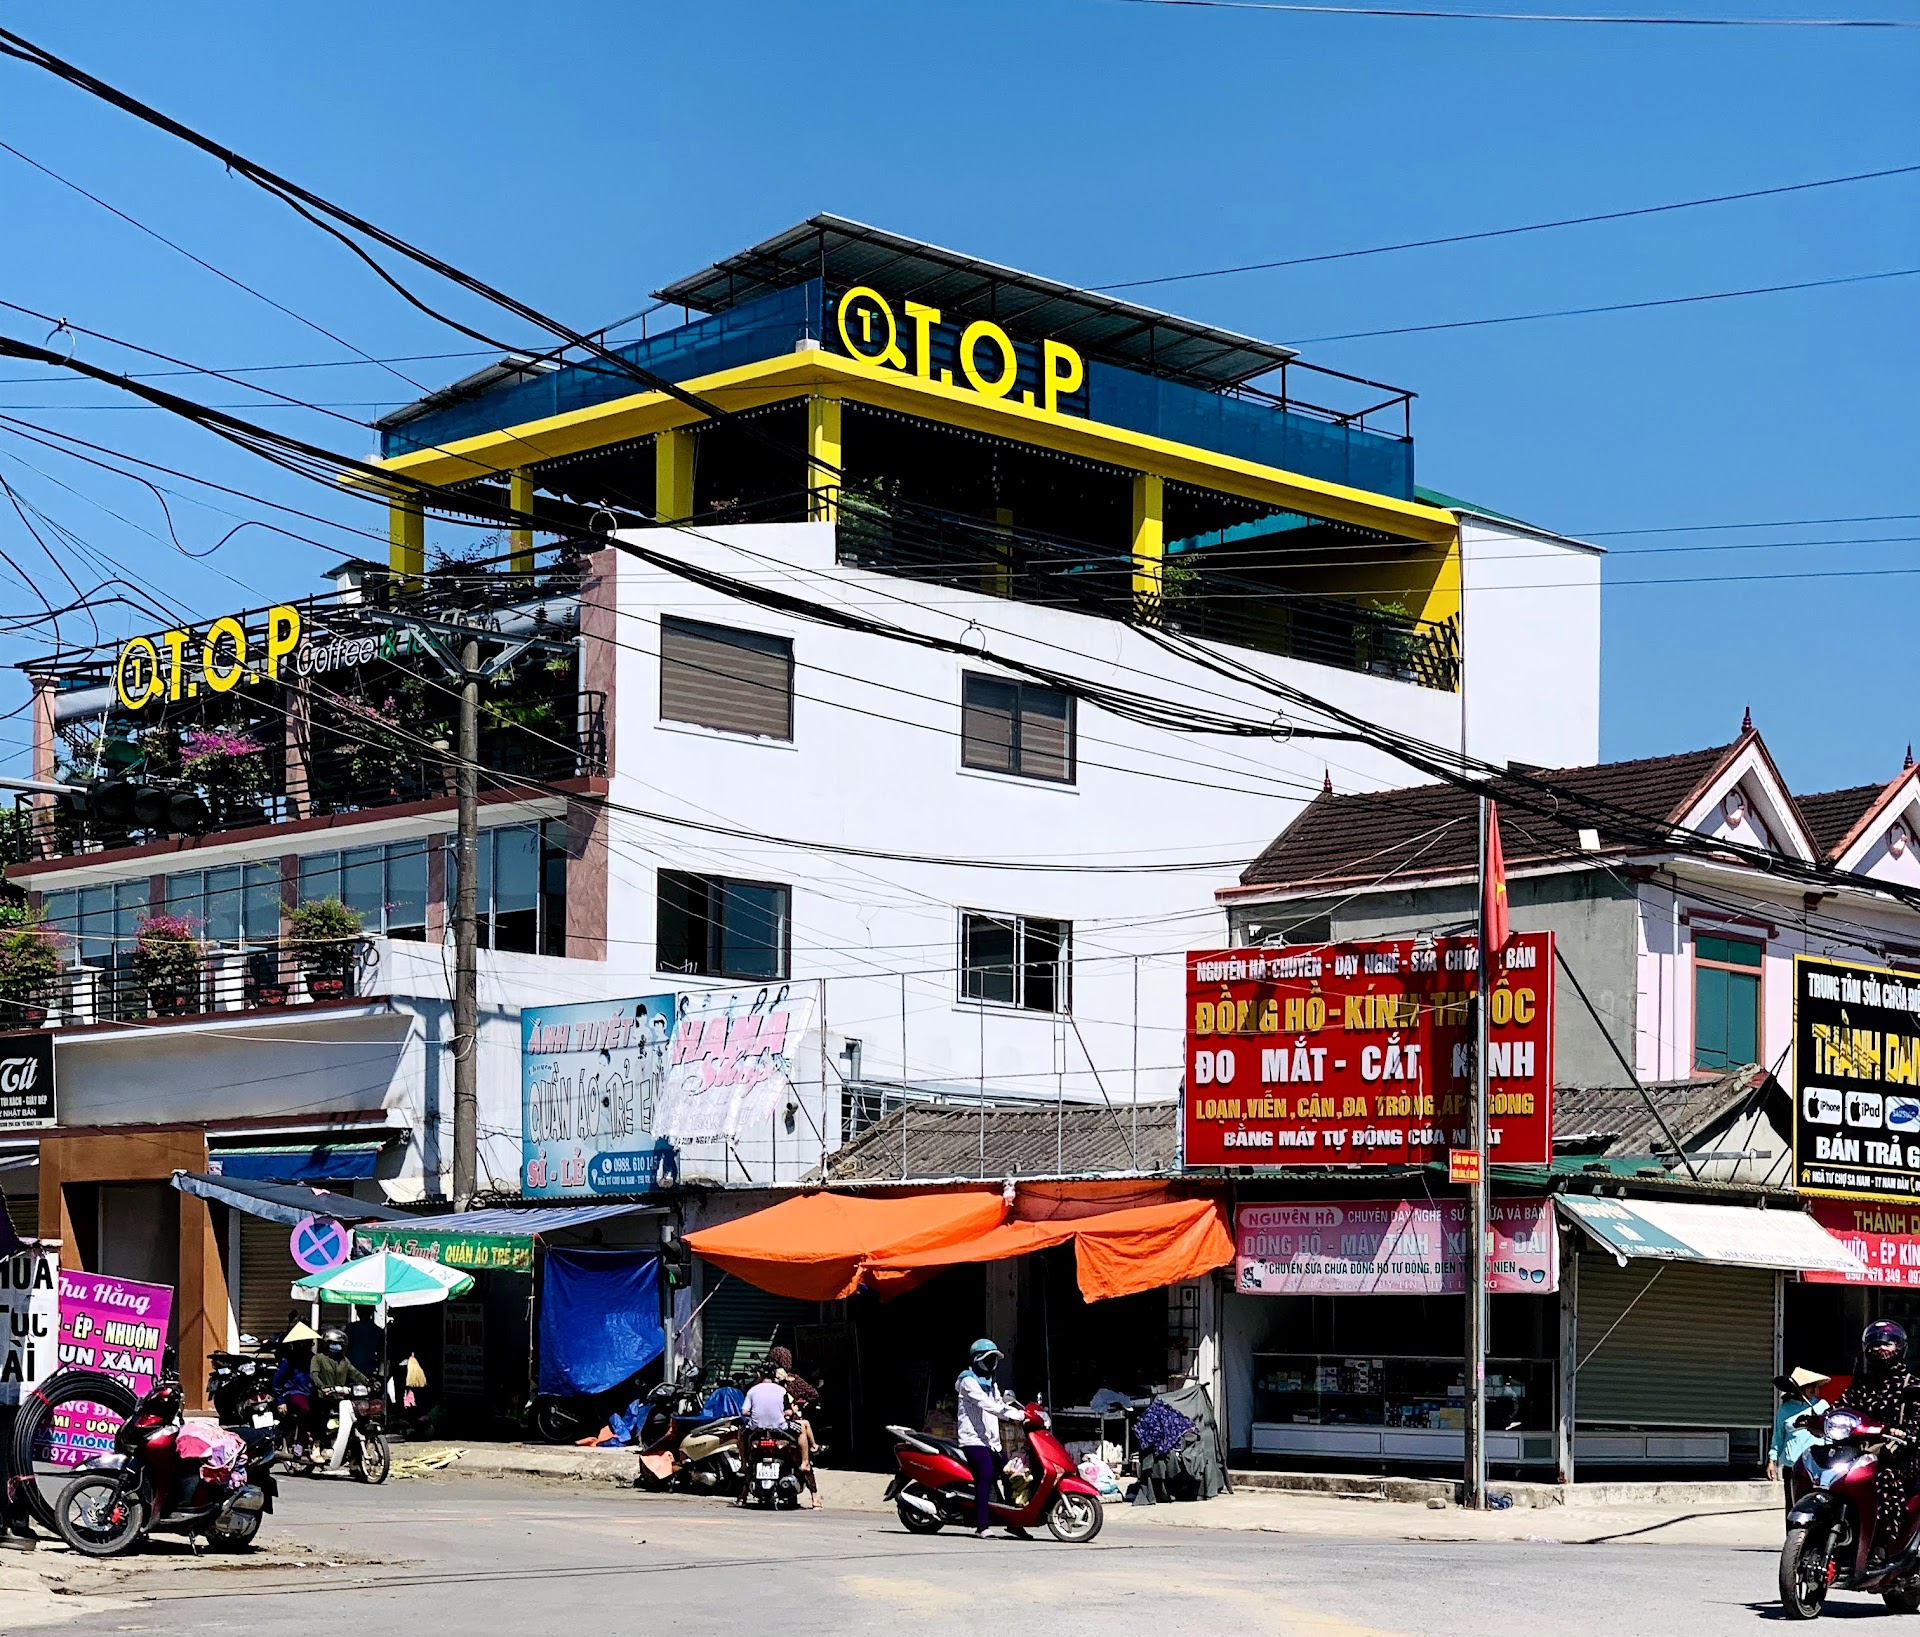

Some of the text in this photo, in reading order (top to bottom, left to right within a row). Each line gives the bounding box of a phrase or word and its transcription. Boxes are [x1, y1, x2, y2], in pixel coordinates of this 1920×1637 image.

[905, 300, 1083, 413] T.O.P
[164, 605, 300, 701] T.O.P
[296, 637, 375, 676] Coffee
[1197, 956, 1246, 982] NGUYÊN
[1272, 953, 1322, 979] CHUYÊN
[1335, 955, 1359, 980] DẠY
[1364, 944, 1400, 974] NGHỀ
[1506, 942, 1536, 969] BÁN
[1195, 970, 1535, 1034] ĐỒNG HỒ KÍNH THỐC
[1808, 973, 1840, 1001] TRUNG
[1841, 973, 1861, 1004] TÂM
[1862, 973, 1881, 1007] SỬA
[1882, 979, 1907, 1011] CHỮA
[575, 1007, 634, 1052] TUYẾT
[1812, 1009, 1881, 1081] THÀNH
[1195, 1031, 1535, 1084] ĐO MẮT CẮT KNH
[529, 1061, 572, 1145] QUẦN
[577, 1068, 600, 1141] ÁO
[606, 1058, 634, 1140] TRẺ
[1820, 1101, 1841, 1112] iPhone
[1862, 1103, 1880, 1118] iPad
[1224, 1123, 1274, 1147] BẰNG
[1279, 1126, 1317, 1147] MÁY
[1322, 1128, 1348, 1150] TỰ
[1352, 1125, 1402, 1150] ĐỘNG
[1408, 1122, 1445, 1145] CỦA
[1816, 1132, 1860, 1162] BÁN
[1864, 1135, 1903, 1166] TRẢ
[561, 1146, 586, 1187] LẺ
[632, 1156, 645, 1171] 610
[1249, 1208, 1306, 1226] NGUYÊN
[1315, 1208, 1336, 1225] HÀ
[1450, 1203, 1467, 1221] SỬ
[1507, 1203, 1523, 1220] VÀ
[1525, 1202, 1546, 1220] BÁN
[1854, 1206, 1906, 1234] THÀNH
[445, 1239, 473, 1263] QUẦN
[475, 1241, 488, 1265] ÁO
[492, 1241, 510, 1265] TRẺ
[1340, 1229, 1381, 1257] MÁY
[1448, 1228, 1494, 1257] KÍH
[1880, 1237, 1896, 1265] ÉP
[1885, 1268, 1901, 1283] 349
[93, 1283, 151, 1315] Hằng
[73, 1312, 93, 1339] ÉP
[104, 1322, 159, 1353] NHUỘM
[0, 1340, 34, 1382] ÀI
[59, 1344, 95, 1366] UN
[100, 1350, 154, 1375] XĂM
